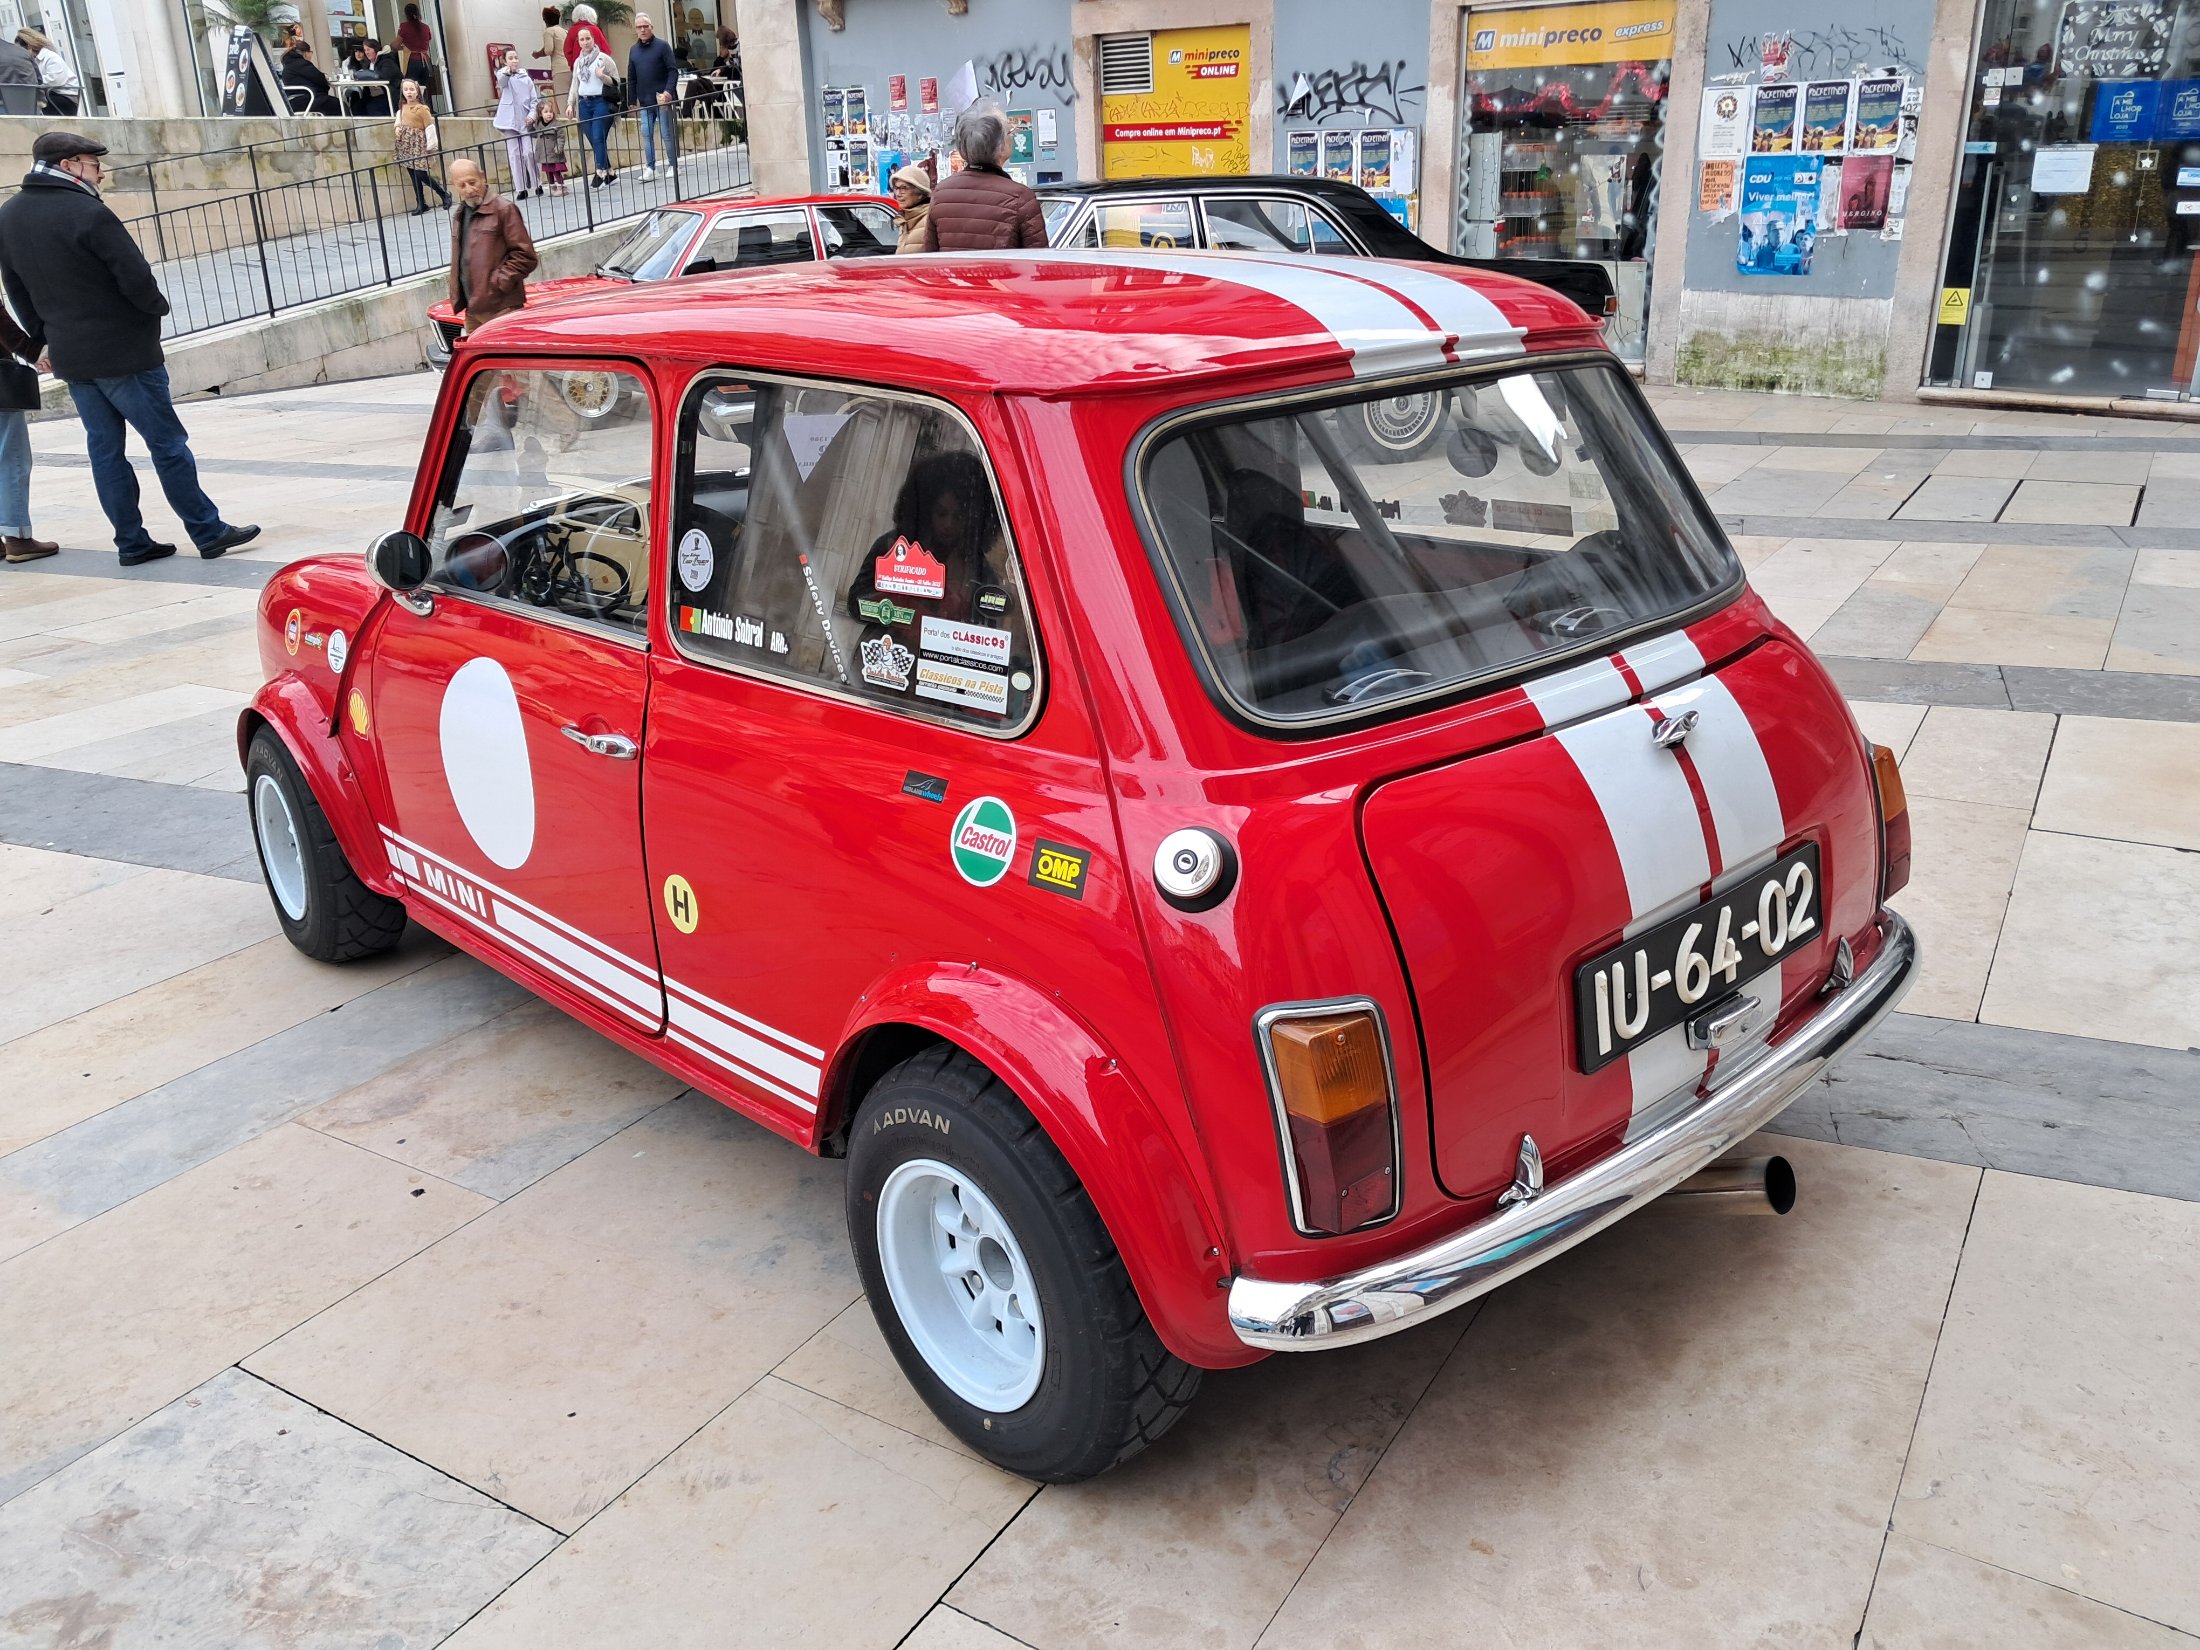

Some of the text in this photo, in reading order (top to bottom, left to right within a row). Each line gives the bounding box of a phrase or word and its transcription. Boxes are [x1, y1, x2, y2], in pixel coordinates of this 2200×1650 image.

[1499, 26, 1603, 48] minipreço
[1614, 20, 1665, 38] express
[2090, 28, 2139, 49] Merry
[1184, 48, 1240, 62] minipreço
[1200, 65, 1237, 76] ONLINE
[1115, 128, 1141, 138] Compre
[1142, 127, 1163, 137] online
[1177, 126, 1222, 137] Minipreco.pt
[1749, 174, 1773, 183] CDU
[1748, 192, 1773, 201] Viver
[701, 608, 734, 640] António
[735, 616, 764, 648] Sobral
[802, 566, 848, 682] Safety Devices
[923, 627, 1005, 649] Portal dos CLÁSSICOS
[922, 651, 1004, 673] www.portalclassicos.com
[964, 679, 977, 689] na
[979, 680, 1004, 695] Pista
[960, 826, 1012, 858] Castrol
[1038, 855, 1081, 882] OMP
[422, 860, 487, 918] MINI
[671, 883, 690, 924] H
[1594, 861, 1816, 1056] IU-64-02
[882, 1107, 951, 1135] ADVAN
